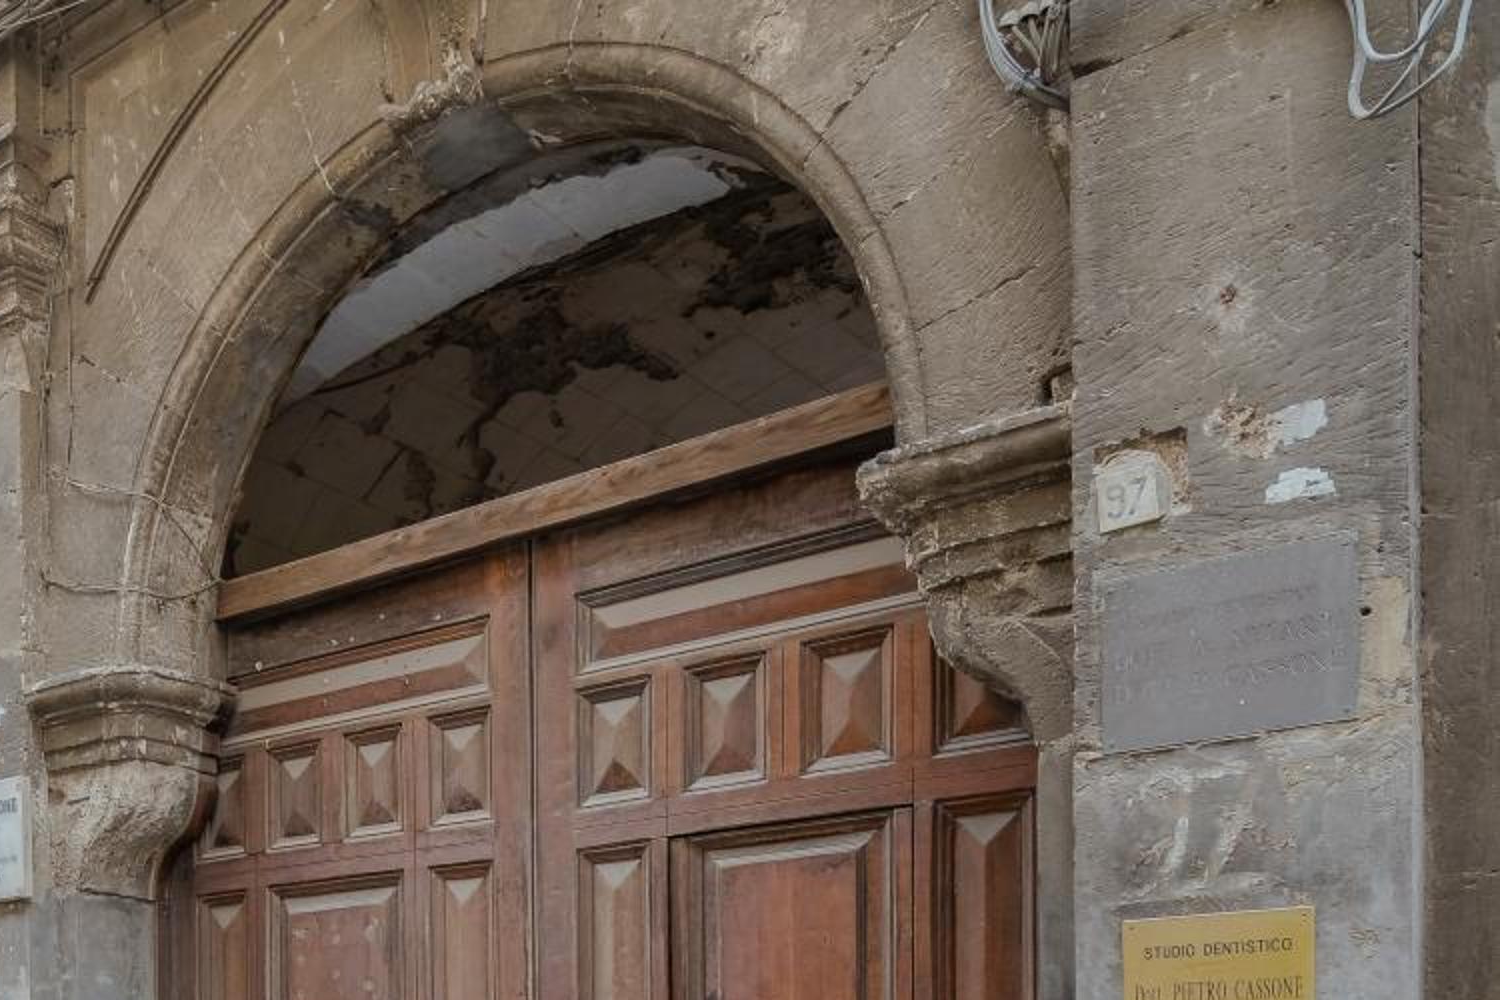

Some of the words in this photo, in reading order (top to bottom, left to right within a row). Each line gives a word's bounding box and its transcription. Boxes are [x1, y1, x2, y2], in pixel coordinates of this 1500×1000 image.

[1143, 943, 1195, 960] STUDIO
[1203, 937, 1293, 957] DENTISTICO
[1234, 975, 1303, 1000] CASSONE
